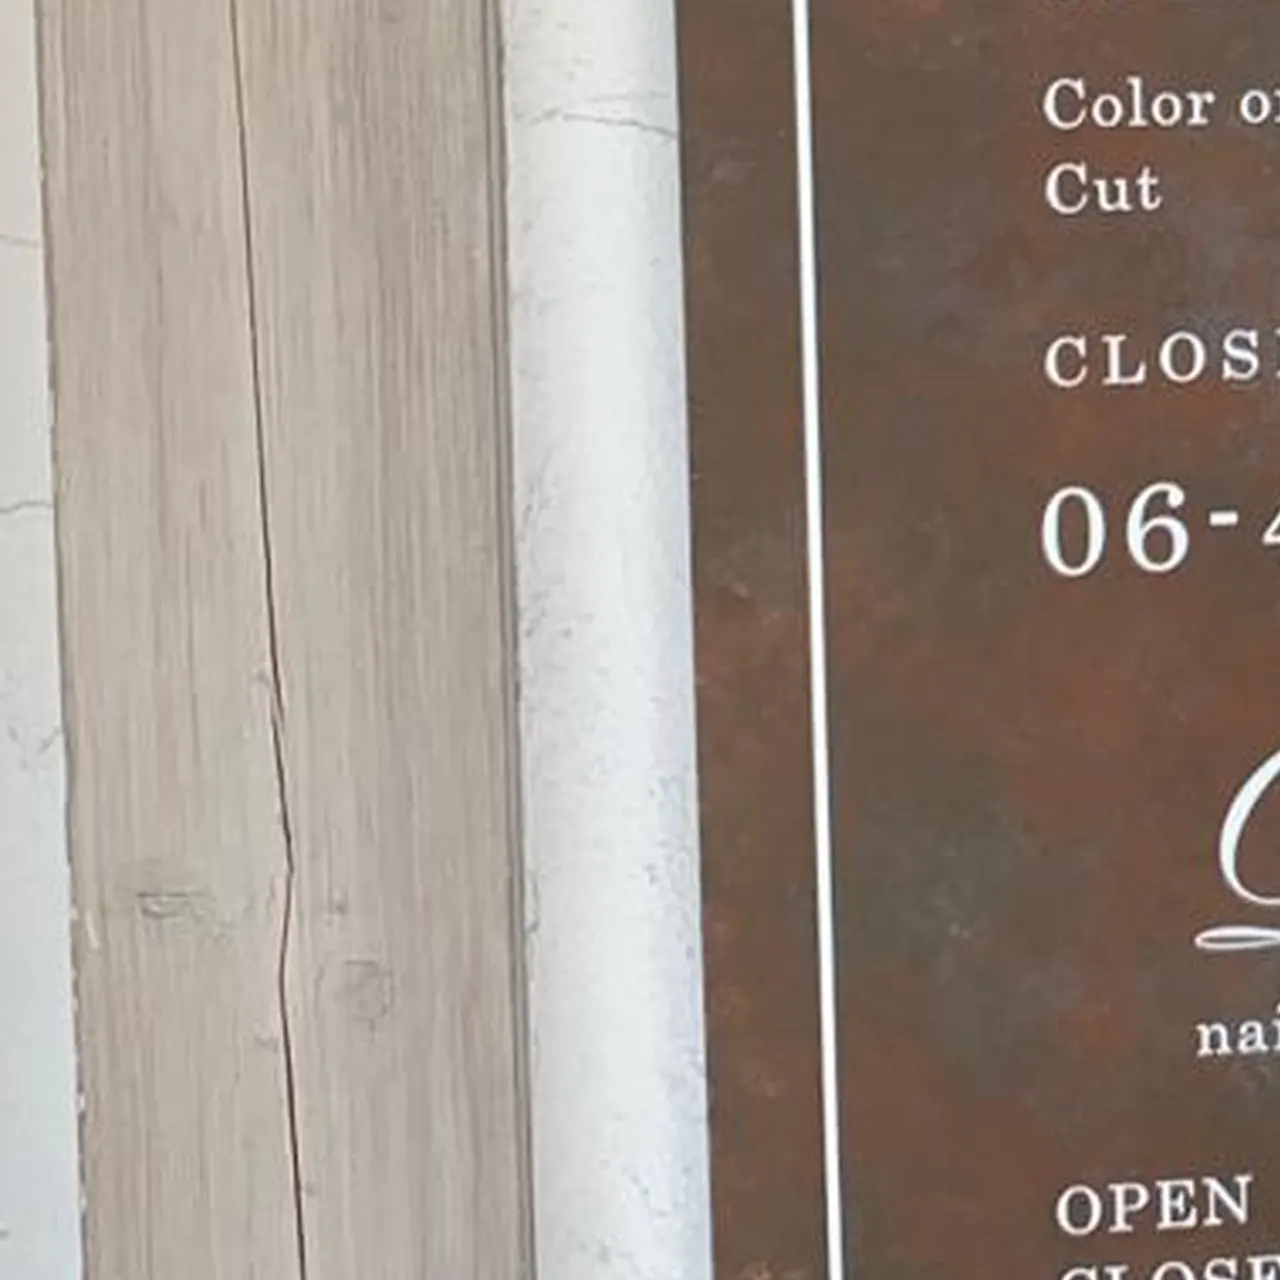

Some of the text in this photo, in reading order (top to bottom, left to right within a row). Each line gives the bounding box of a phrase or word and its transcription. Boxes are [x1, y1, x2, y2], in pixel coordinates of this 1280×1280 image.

[1041, 75, 1216, 131] Color
[1043, 162, 1163, 215] Cut
[1055, 1173, 1254, 1237] OPEN
